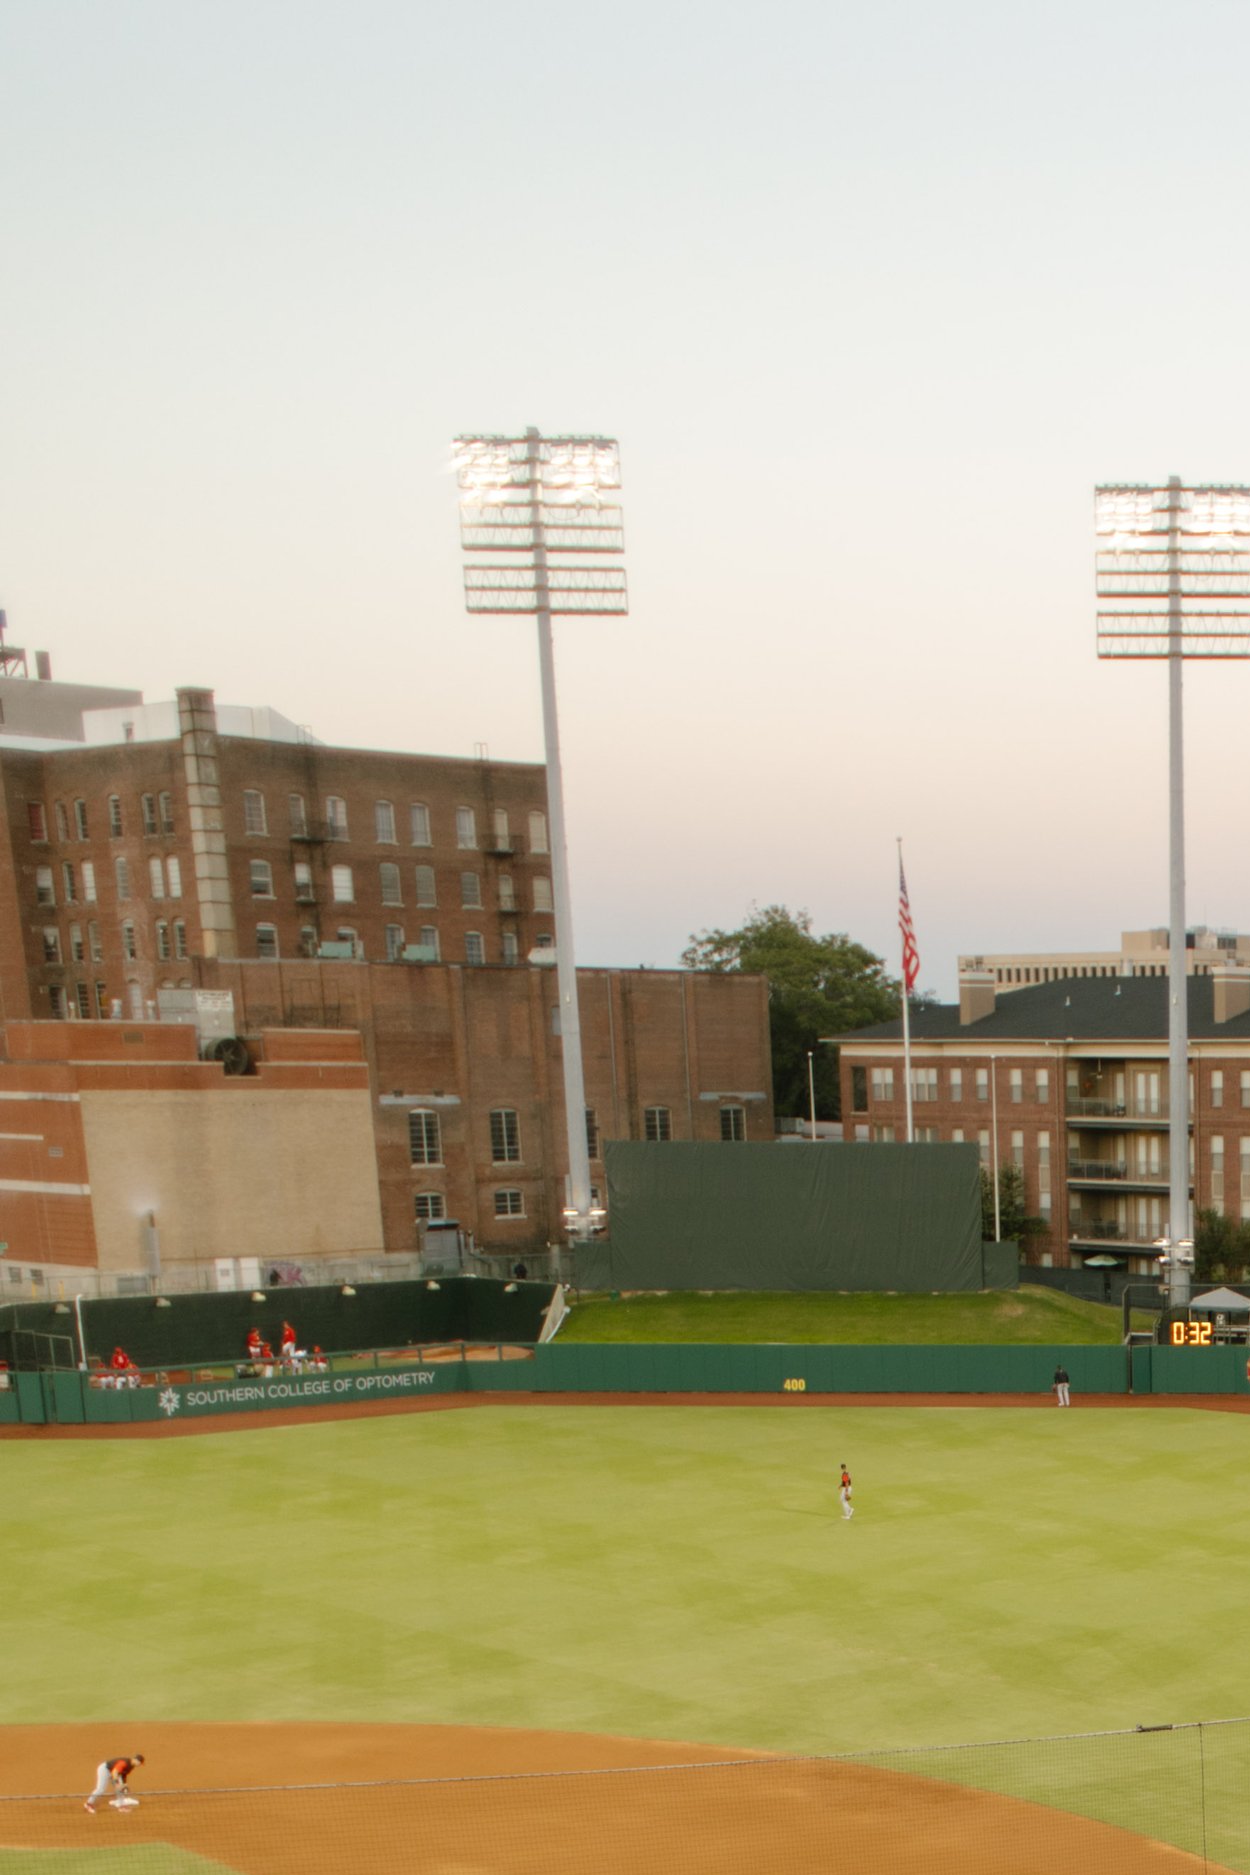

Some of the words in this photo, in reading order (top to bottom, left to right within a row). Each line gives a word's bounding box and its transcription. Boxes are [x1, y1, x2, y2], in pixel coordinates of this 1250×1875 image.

[1172, 1321, 1212, 1345] 0:32
[187, 1384, 265, 1406] SOUTHERN
[267, 1380, 331, 1398] COLLEGE
[333, 1378, 353, 1392] OF
[356, 1371, 436, 1391] OPTOMETRY
[783, 1378, 806, 1391] 400
